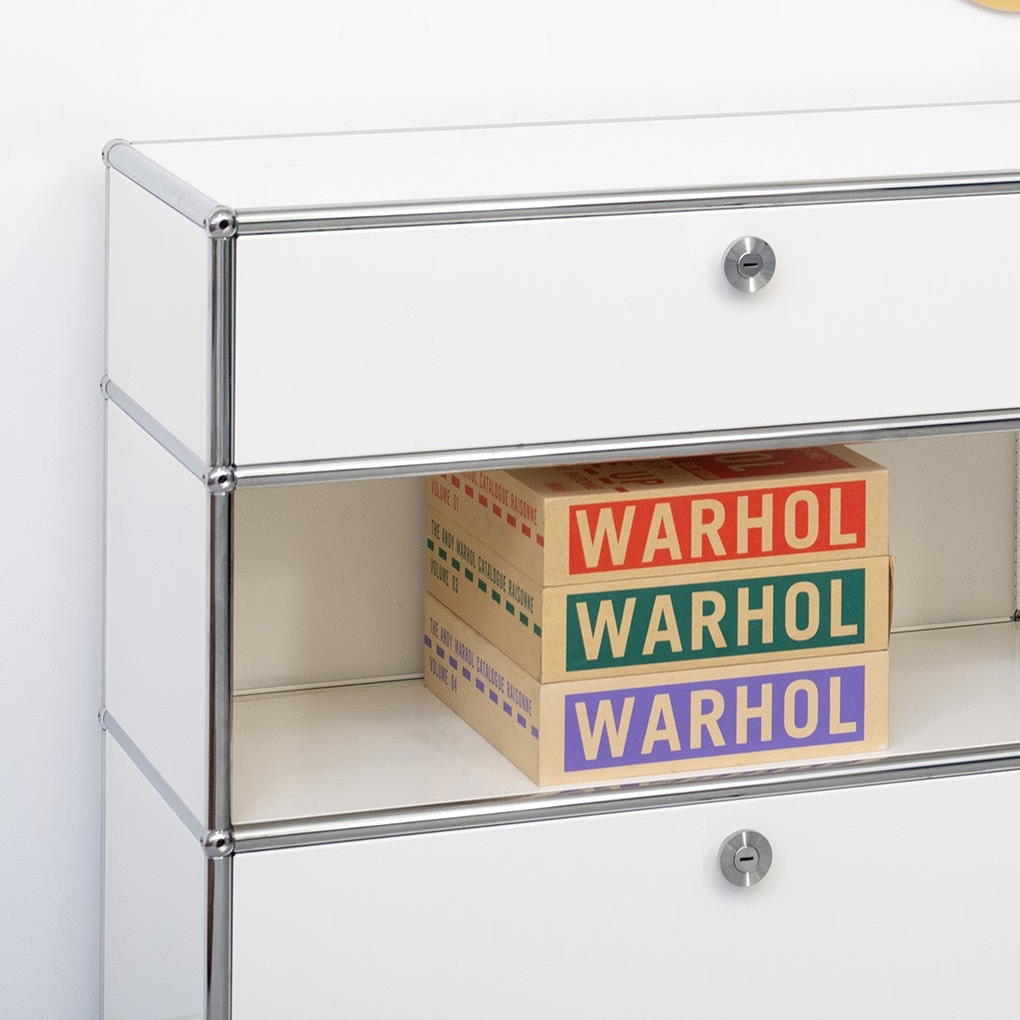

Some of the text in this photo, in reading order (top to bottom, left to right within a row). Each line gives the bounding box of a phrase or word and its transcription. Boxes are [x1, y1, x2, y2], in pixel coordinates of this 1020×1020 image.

[575, 487, 857, 568] WARHOL
[575, 578, 858, 661] WARHOL
[574, 676, 856, 761] WARHOL
